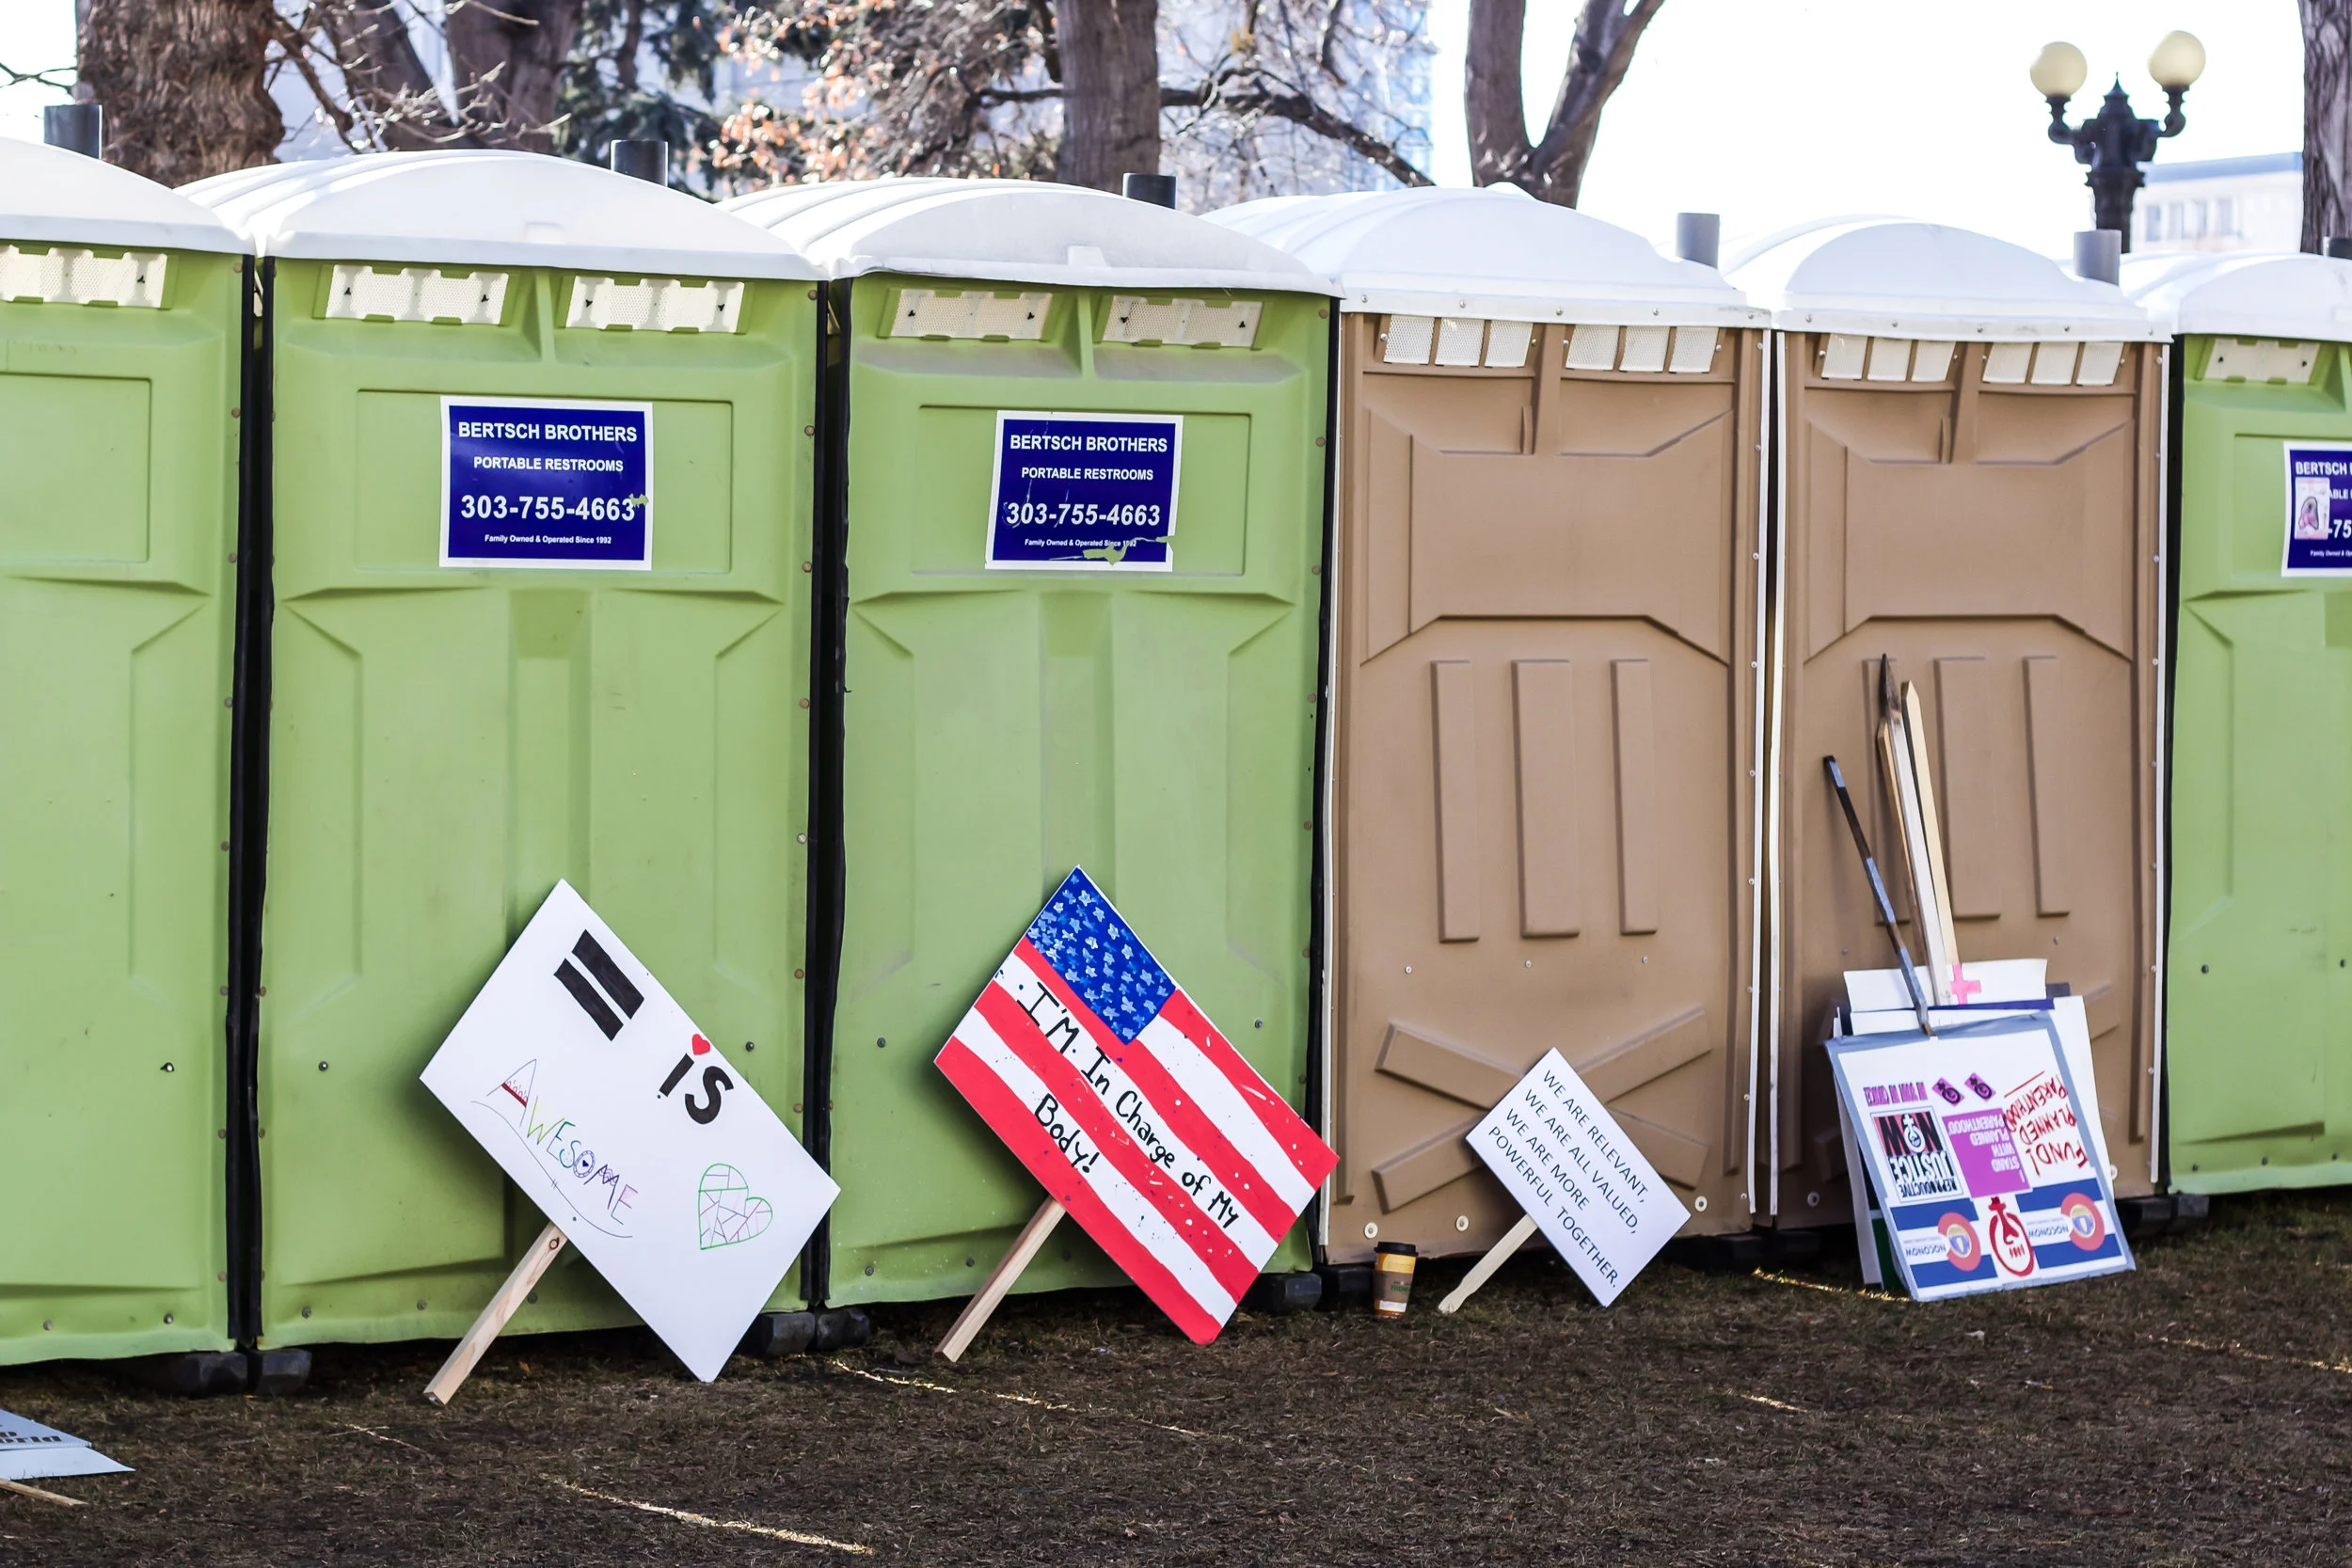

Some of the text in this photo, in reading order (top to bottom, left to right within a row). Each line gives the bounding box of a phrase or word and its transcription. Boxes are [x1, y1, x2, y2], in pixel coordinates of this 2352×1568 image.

[458, 422, 638, 442] BERTSCH BROTHERS
[1009, 434, 1168, 452] BERTSCH BROTHERS
[473, 456, 624, 472] PORTABLE RESTROOMS
[1021, 467, 1154, 481] PORTABLE RESTROOMS
[2295, 461, 2347, 476] BERTSCH
[460, 495, 635, 522] 303-755-4663
[1006, 502, 1160, 527] 303-755-4663
[485, 534, 508, 544] Family
[509, 534, 534, 543] Owned
[542, 535, 574, 545] Operated
[575, 535, 595, 544] Since
[1025, 538, 1045, 547] Family
[1046, 538, 1068, 546] Owned
[1074, 539, 1104, 547] Operated
[1016, 981, 1239, 1229] I'M In Charge of My
[1034, 1093, 1101, 1174] Body!
[1543, 1069, 1648, 1203] WE ARE RELEVANT,
[2019, 1103, 2076, 1146] PLANNED
[1969, 1128, 2010, 1147] PLANNED
[1506, 1108, 1590, 1212] WE ARE MORE
[1991, 1141, 2016, 1158] WITH
[2026, 1139, 2088, 1178] FUND!
[1525, 1088, 1639, 1235] WE ARE ALL VALUED,
[1888, 1150, 1954, 1183] JUSTICE
[1991, 1155, 2020, 1172] STAND
[1899, 1177, 1958, 1198] REPRODUCTIVE
[1488, 1125, 1619, 1288] POWERFUL TOGETHER.
